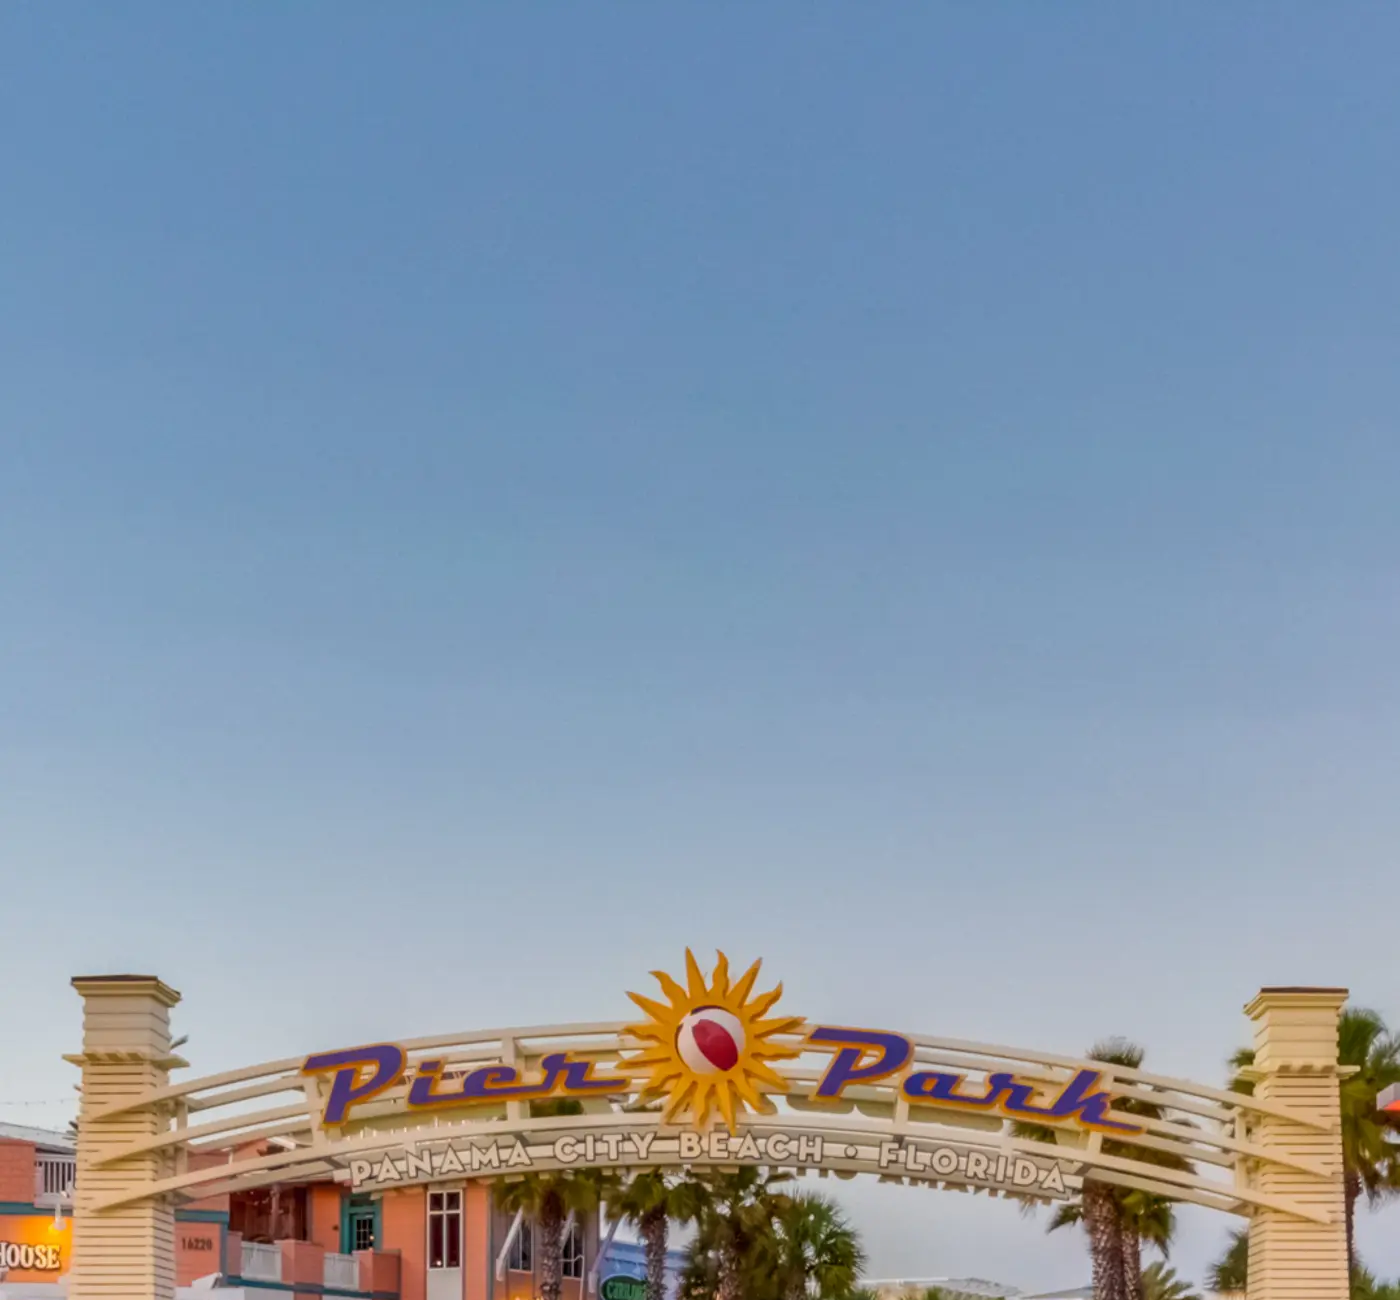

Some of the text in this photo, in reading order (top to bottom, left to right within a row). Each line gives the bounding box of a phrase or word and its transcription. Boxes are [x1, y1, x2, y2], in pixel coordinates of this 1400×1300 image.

[303, 1026, 1147, 1136] Pier Park
[350, 1130, 1067, 1194] PANAMA CITY BEACH FLORIDA
